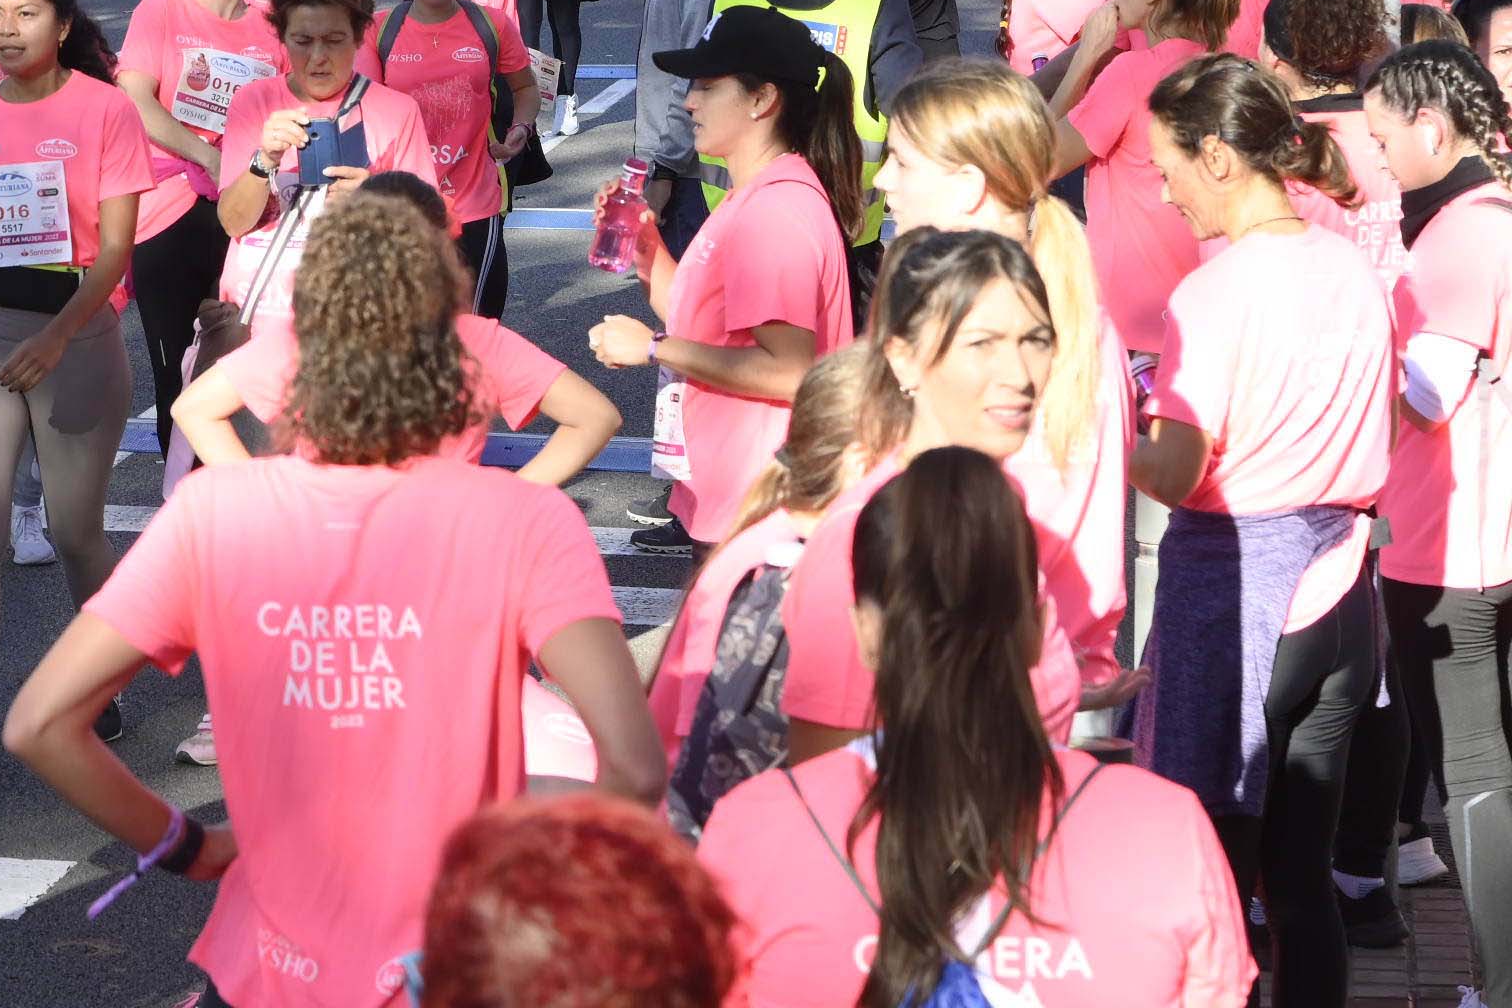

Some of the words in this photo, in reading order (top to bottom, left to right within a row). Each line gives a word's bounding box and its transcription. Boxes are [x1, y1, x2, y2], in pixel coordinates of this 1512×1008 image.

[179, 107, 207, 122] OYSHO
[1, 223, 24, 234] 5517
[29, 247, 64, 257] Santander
[256, 600, 424, 640] CARRERA
[290, 640, 336, 675] DE
[349, 640, 394, 673] LA
[282, 674, 407, 710] MUJER
